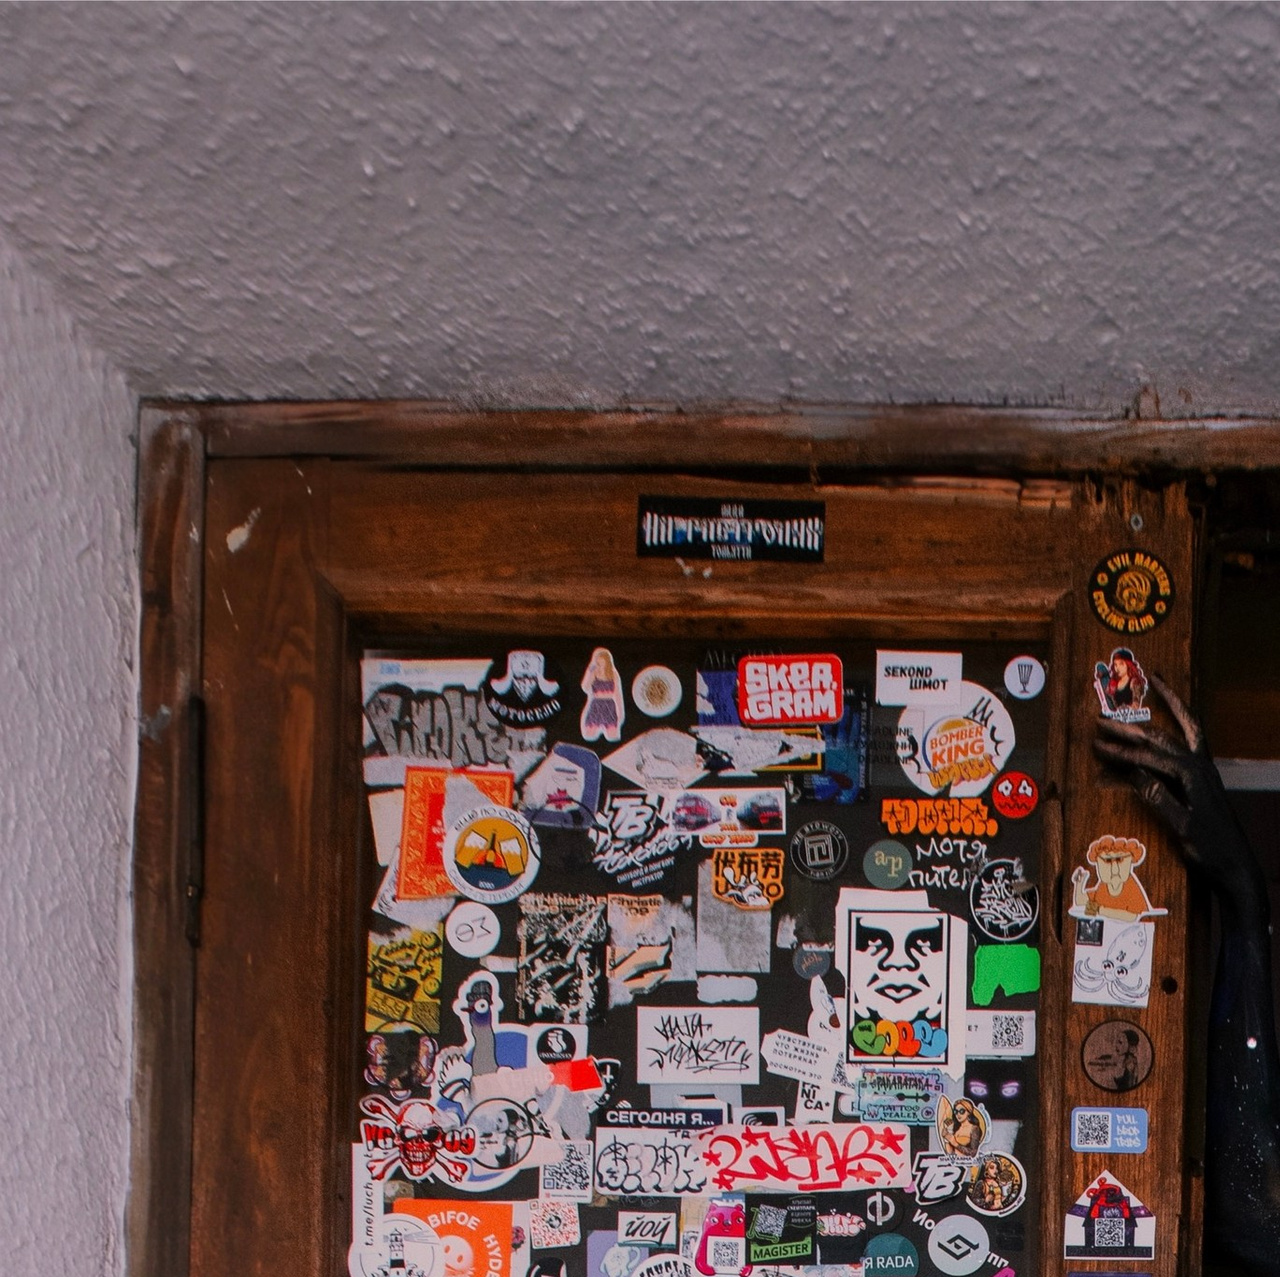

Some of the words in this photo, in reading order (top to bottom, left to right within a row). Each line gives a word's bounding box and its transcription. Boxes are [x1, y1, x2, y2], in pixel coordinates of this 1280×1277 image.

[930, 725, 984, 750] BOMBER
[932, 738, 985, 767] KING
[774, 1041, 791, 1051] ЧТО
[794, 1046, 820, 1058] ЖИЗНЬ
[606, 1110, 686, 1125] СЕГОДНЯ
[690, 1112, 715, 1126] Я...
[427, 1210, 480, 1231] BIFOE
[753, 1242, 809, 1260] MAGISTER
[877, 1256, 915, 1269] RADA
